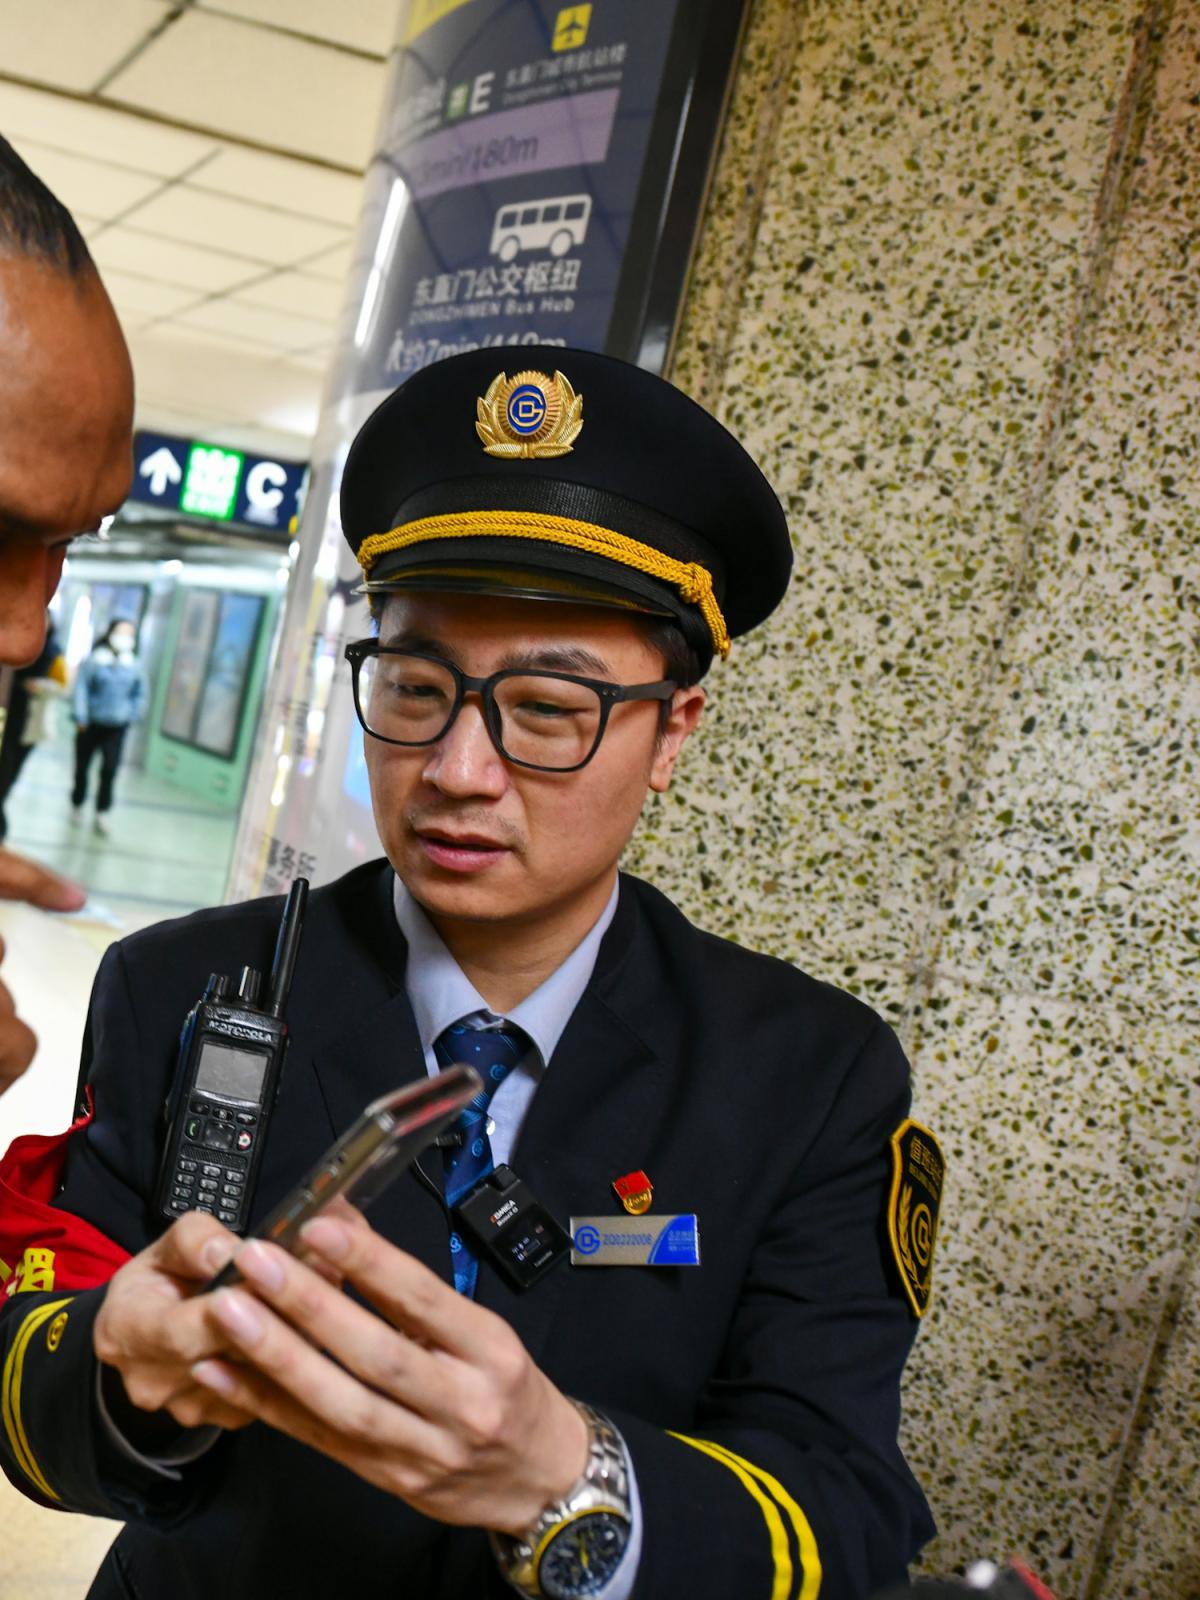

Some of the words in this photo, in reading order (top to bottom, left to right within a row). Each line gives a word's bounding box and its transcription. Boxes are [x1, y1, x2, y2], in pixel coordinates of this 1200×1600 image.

[468, 71, 496, 114] E
[412, 259, 582, 307] 东直门公交枢纽
[504, 299, 535, 316] Bus
[540, 295, 576, 313] Hub
[246, 462, 288, 508] C
